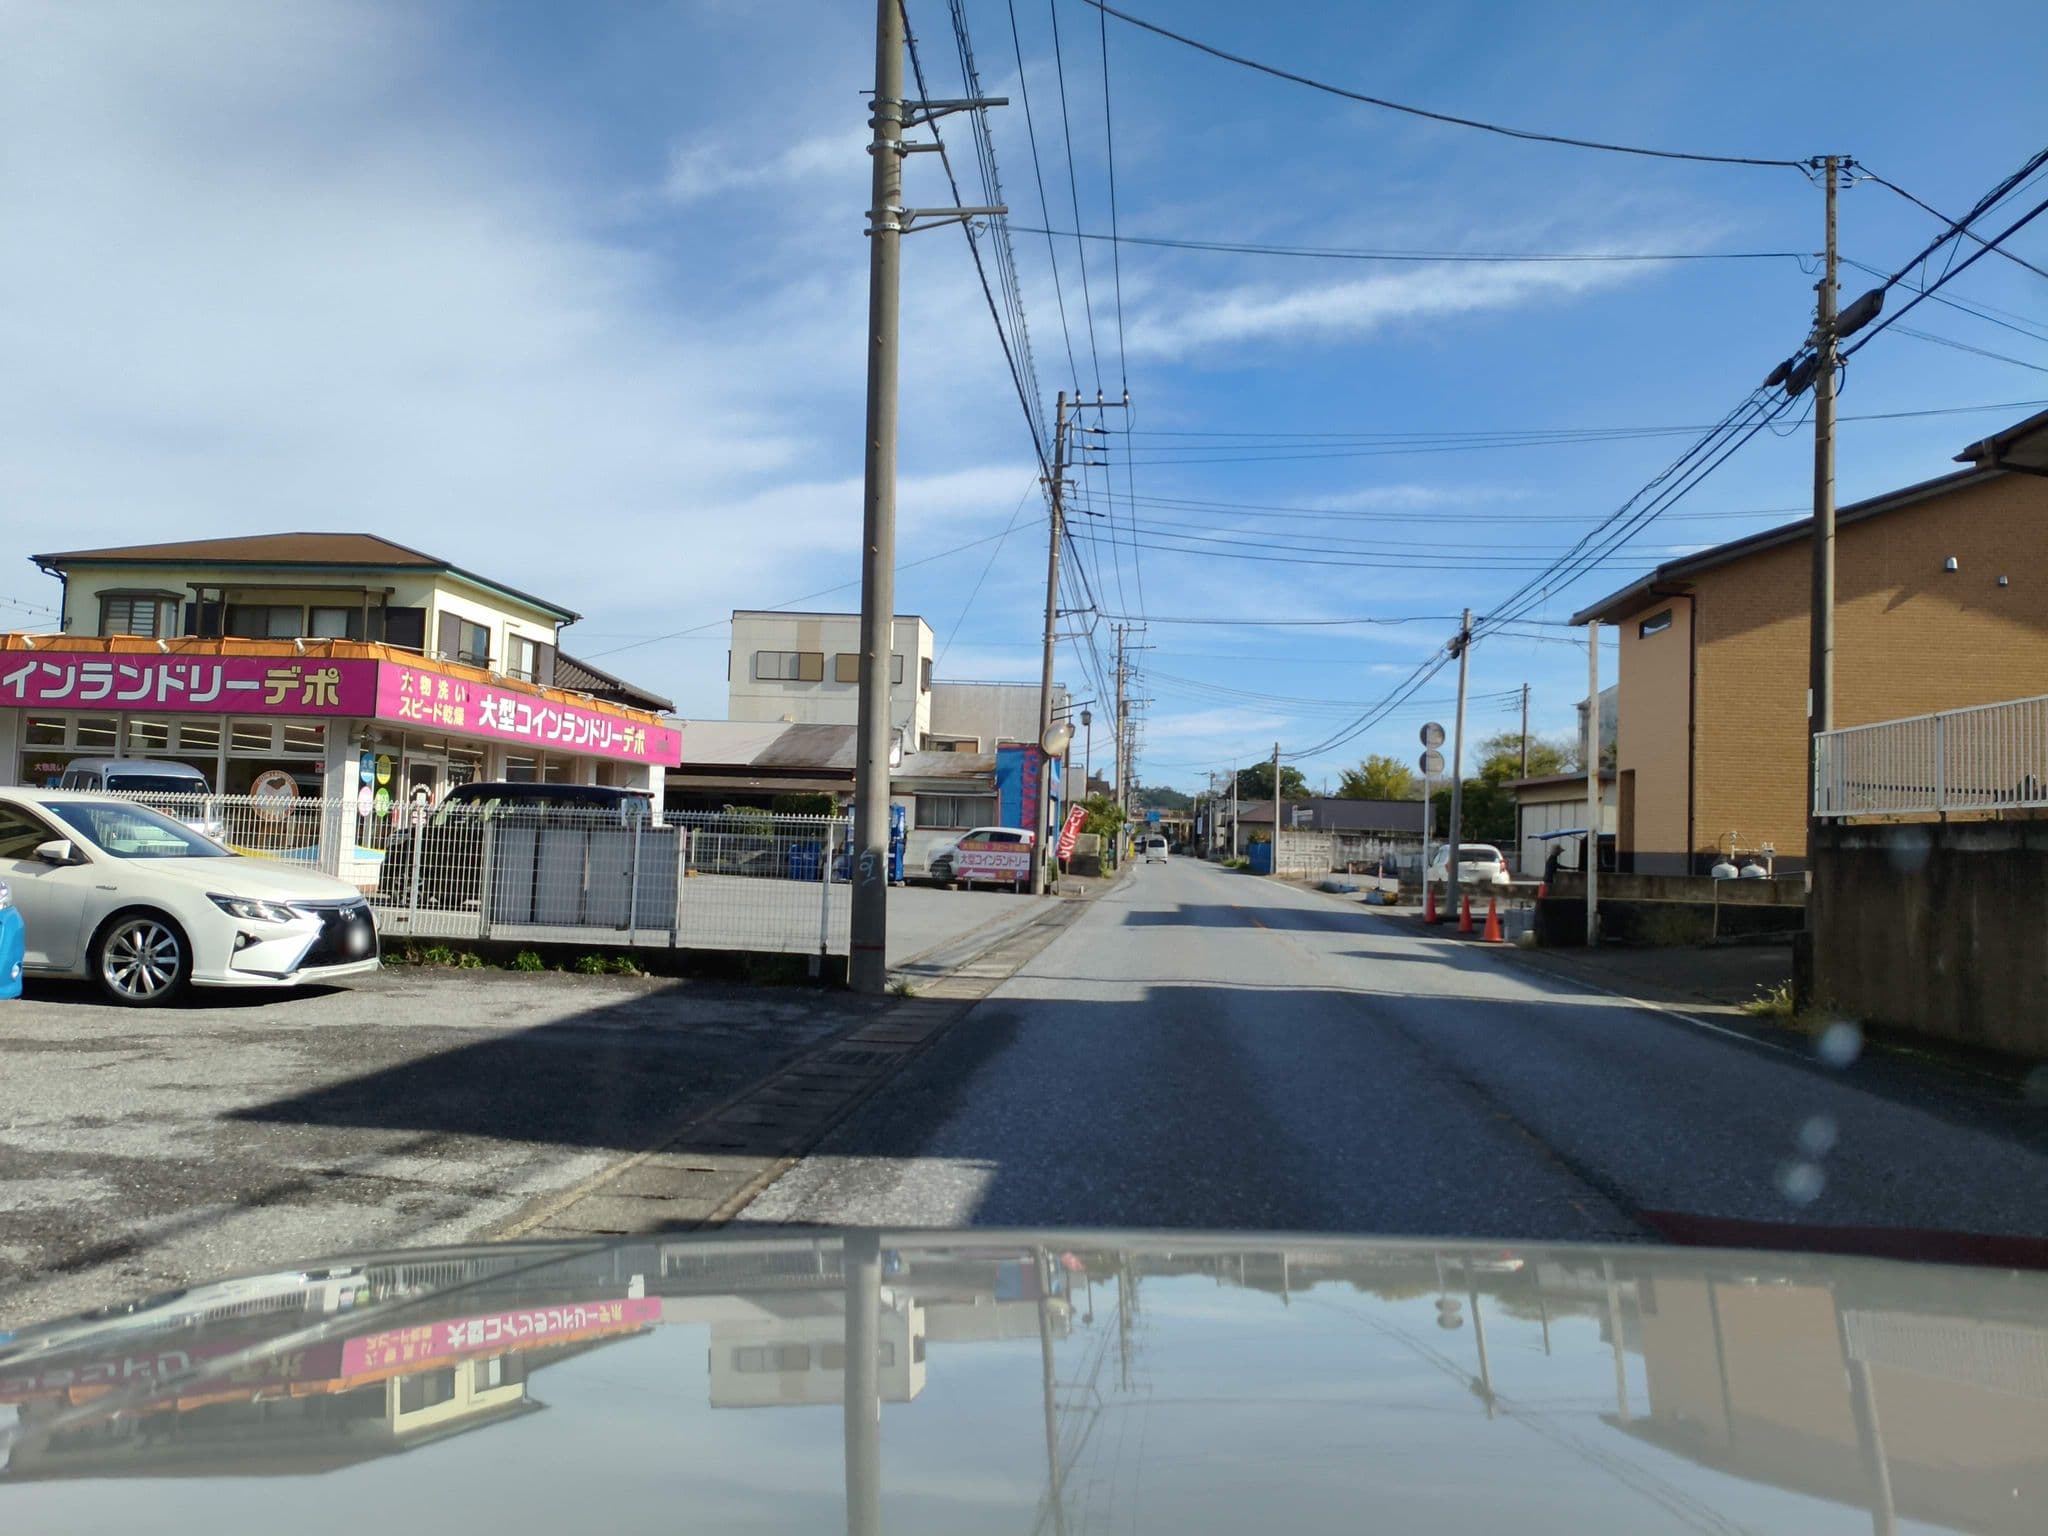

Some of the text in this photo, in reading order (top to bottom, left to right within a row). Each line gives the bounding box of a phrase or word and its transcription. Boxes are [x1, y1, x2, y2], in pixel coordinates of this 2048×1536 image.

[2, 661, 341, 706] インランドリーデポ
[401, 671, 466, 703] 大物洗い
[399, 696, 465, 727] スピード乾燥
[478, 694, 645, 755] 大型コインランドリーデポ
